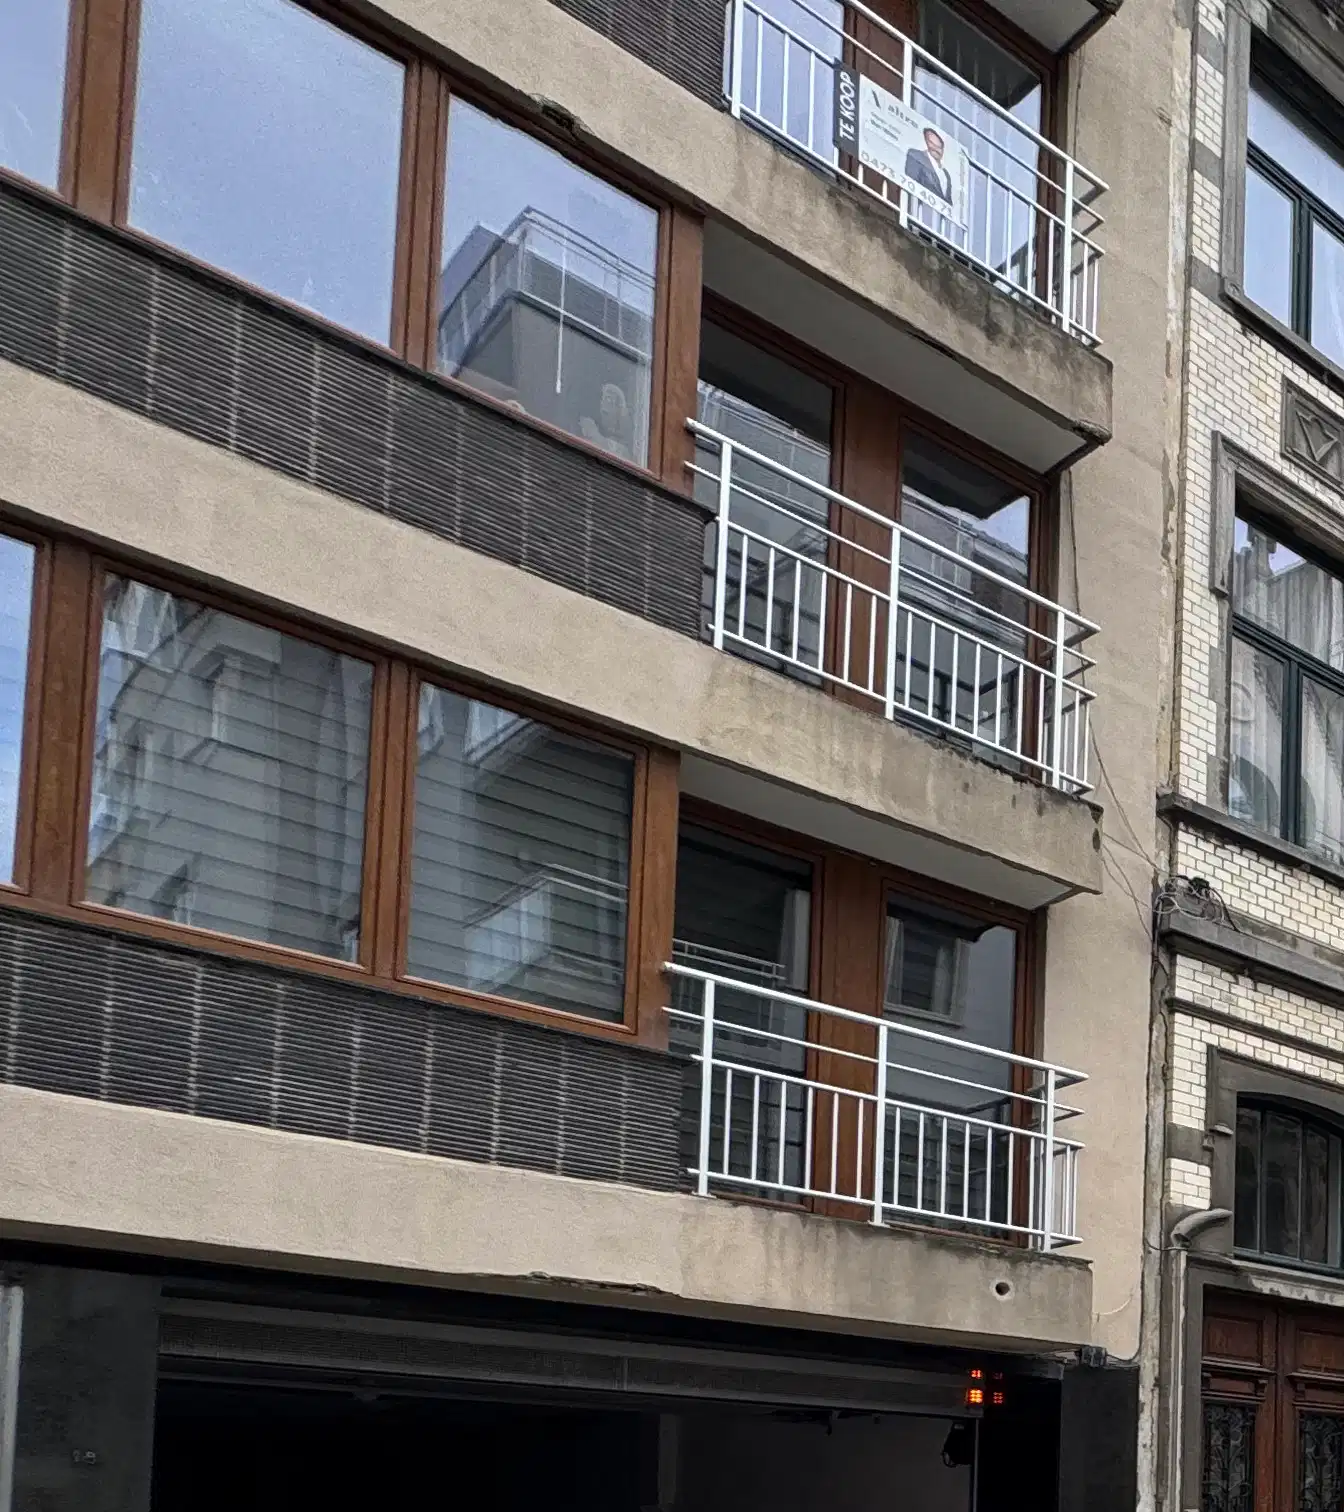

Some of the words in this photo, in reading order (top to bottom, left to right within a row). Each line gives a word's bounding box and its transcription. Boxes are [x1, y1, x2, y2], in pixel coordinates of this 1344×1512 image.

[839, 71, 855, 122] KOOP
[839, 117, 855, 141] TE
[861, 151, 895, 178] 0473
[900, 174, 916, 192] 70
[919, 190, 937, 206] 40
